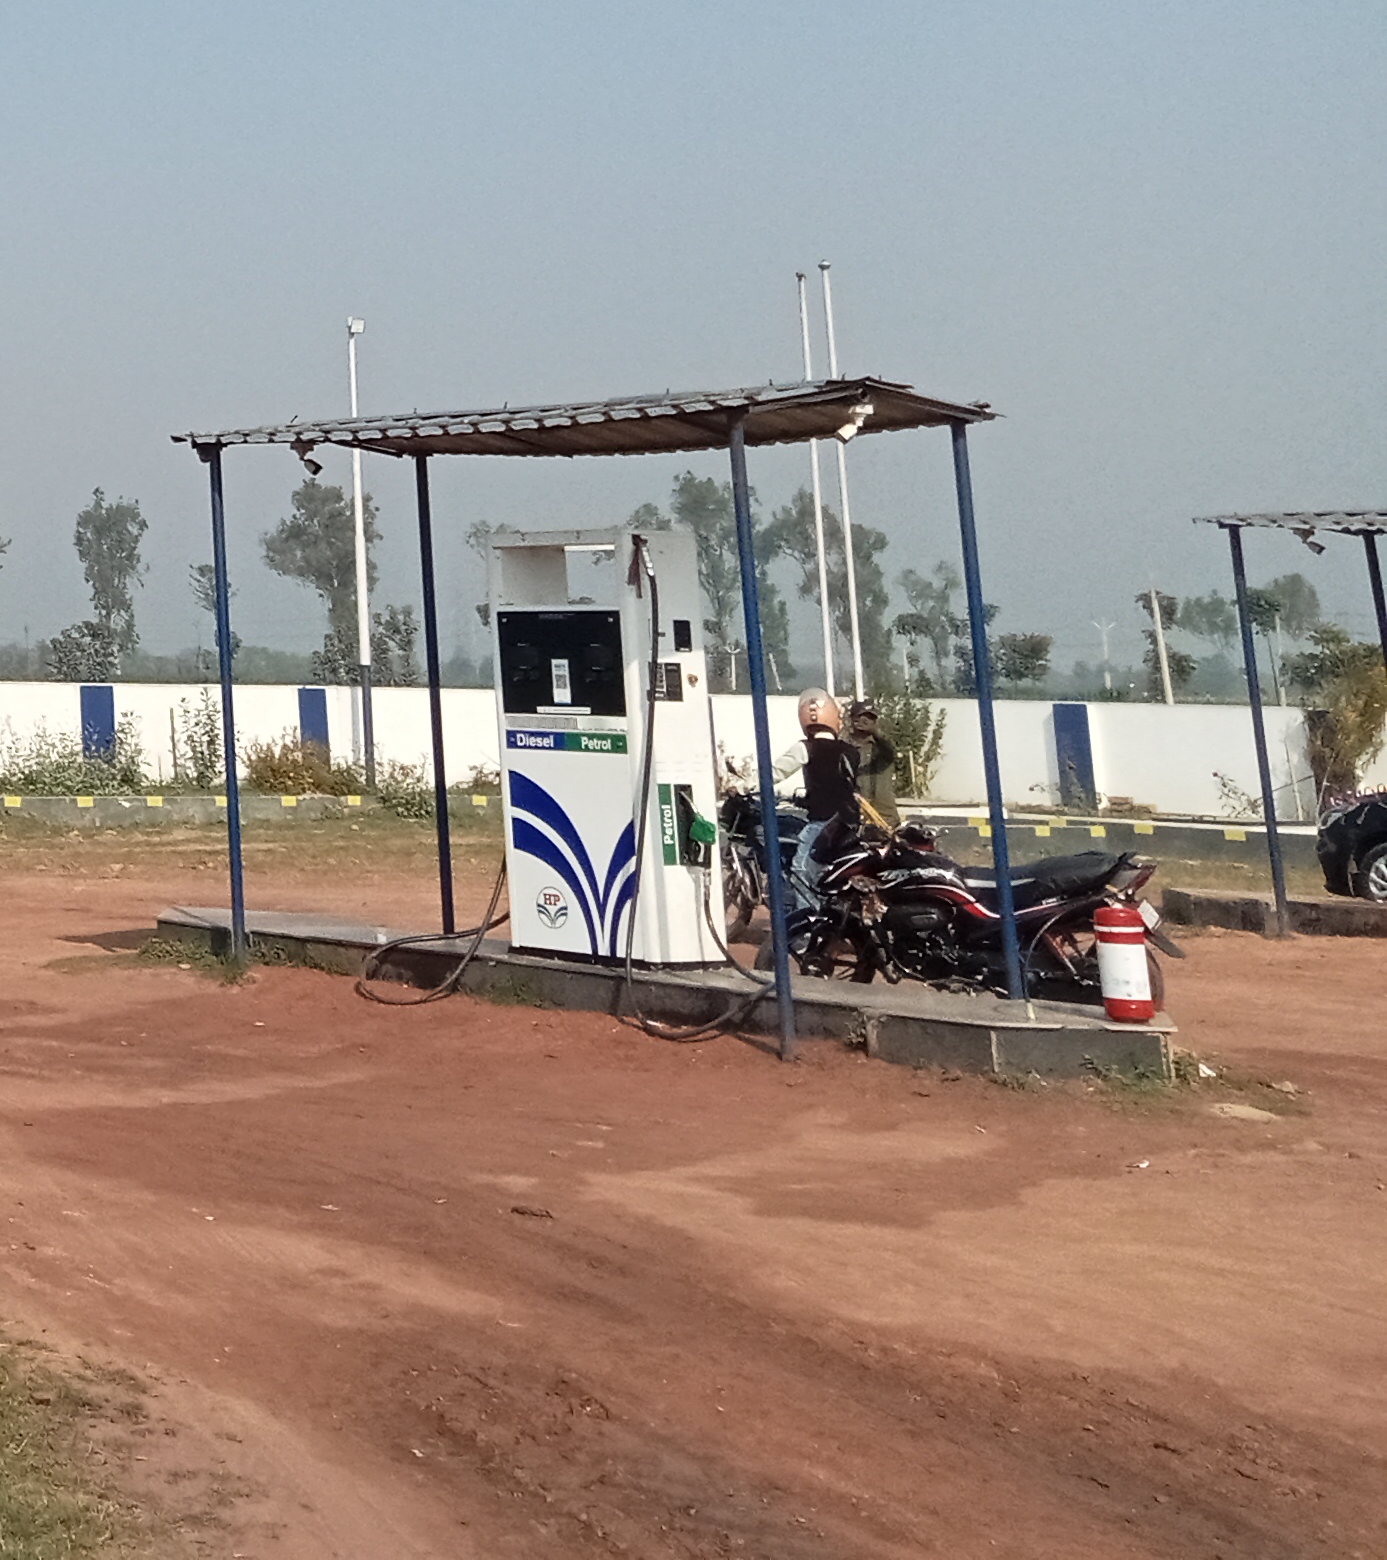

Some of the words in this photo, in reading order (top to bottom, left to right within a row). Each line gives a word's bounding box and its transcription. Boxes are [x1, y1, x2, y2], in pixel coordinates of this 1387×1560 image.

[516, 732, 555, 748] Diesel
[580, 735, 612, 751] Petrol
[662, 804, 675, 845] Petrol
[542, 892, 561, 907] HP
